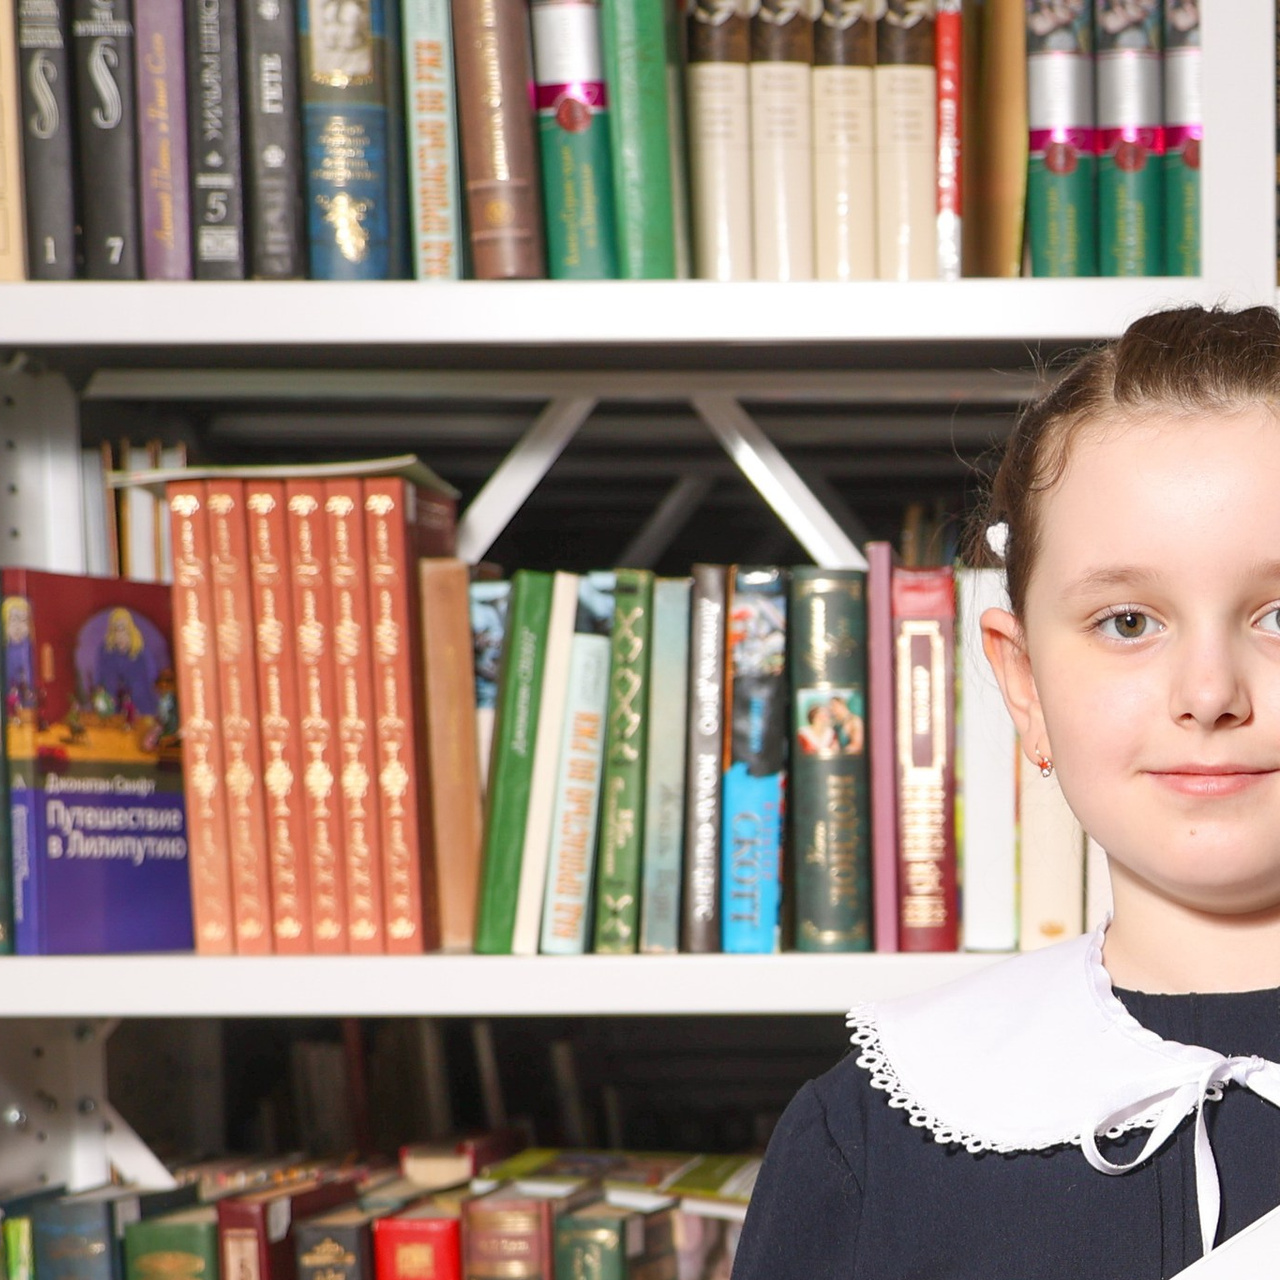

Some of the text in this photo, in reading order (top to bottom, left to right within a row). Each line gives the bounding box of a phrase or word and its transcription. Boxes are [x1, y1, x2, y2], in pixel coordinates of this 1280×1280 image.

[413, 40, 445, 83] РЖИ
[416, 121, 450, 234] ПРОПАСТЬЮ
[206, 192, 228, 222] 5
[106, 236, 124, 265] 7
[419, 242, 452, 278] НАД
[46, 799, 184, 836] Путешествие
[551, 711, 602, 940] НАД ПРОПАСТЬЮ ВО РЖИ
[47, 830, 188, 867] в Лилипутию
[730, 812, 762, 928] СКОТТ
